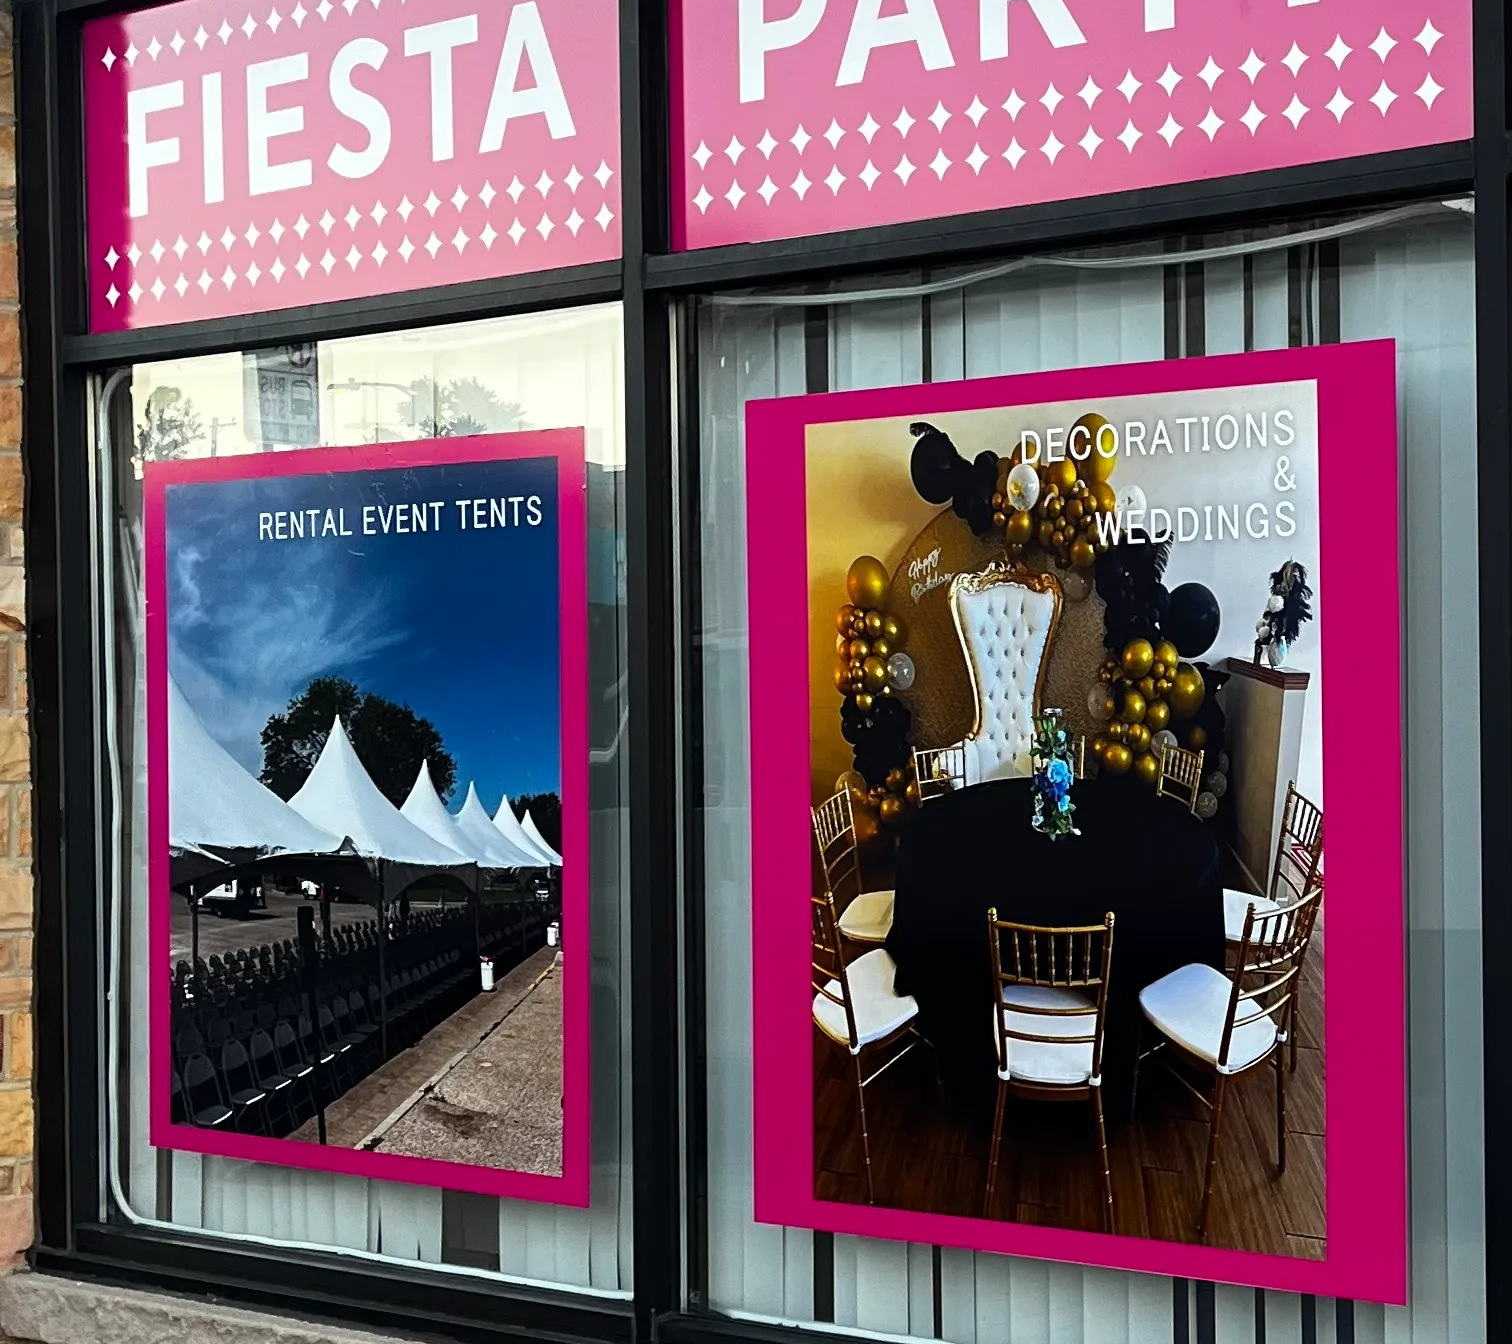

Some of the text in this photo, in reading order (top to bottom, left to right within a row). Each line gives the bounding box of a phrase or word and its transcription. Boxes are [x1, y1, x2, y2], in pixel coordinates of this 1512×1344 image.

[126, 0, 578, 218] FIESTA
[1020, 408, 1296, 467] DECORATIONS
[1273, 456, 1298, 493] &
[258, 494, 543, 542] RENTAL EVENT TENTS
[1094, 499, 1298, 547] WEDDINGS
[908, 547, 942, 580] Happy
